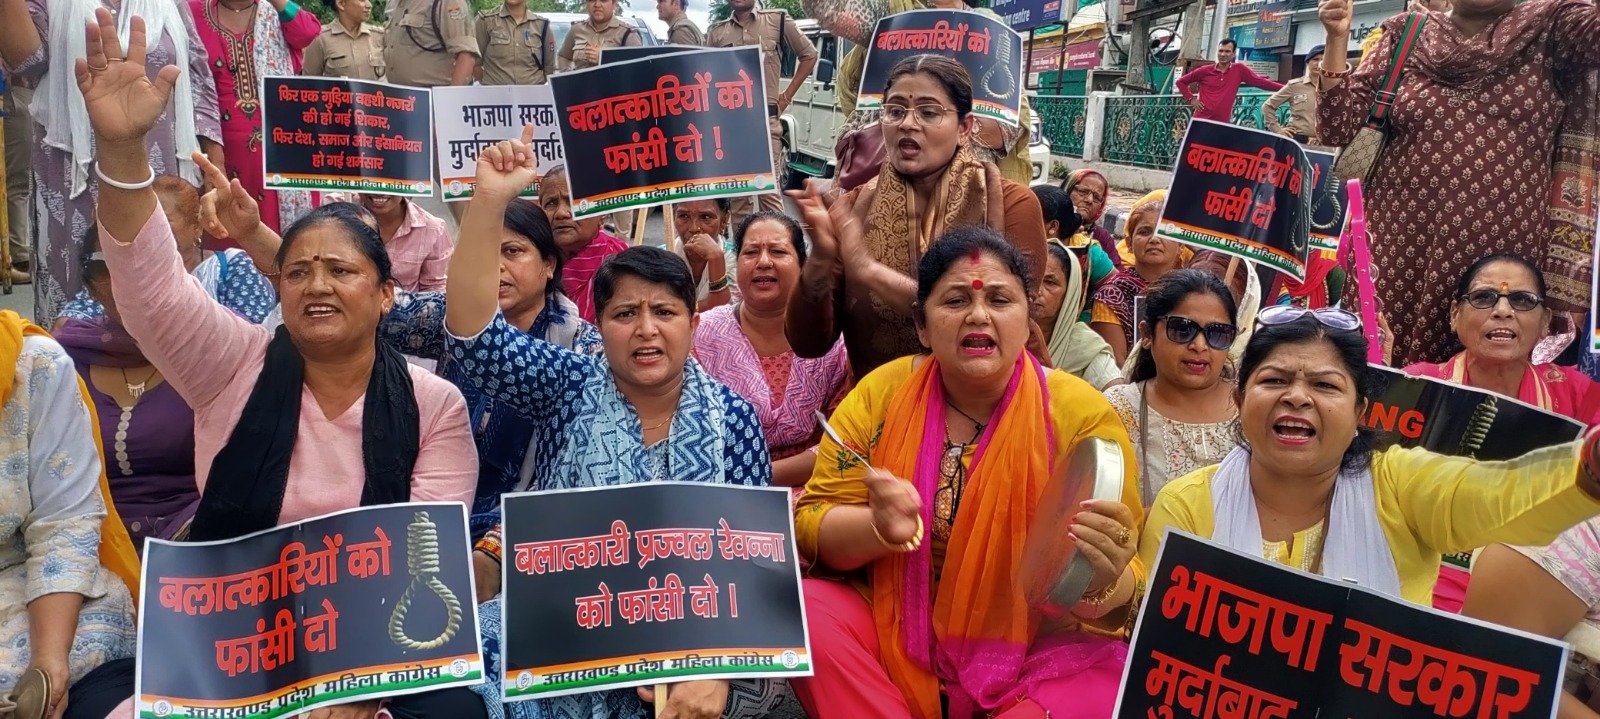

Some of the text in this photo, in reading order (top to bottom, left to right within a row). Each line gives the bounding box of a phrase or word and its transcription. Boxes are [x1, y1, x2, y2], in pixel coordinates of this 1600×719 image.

[877, 20, 992, 55] बलात्कारियों को
[279, 84, 299, 102] फिर
[301, 90, 319, 103] एक
[462, 105, 513, 127] भाजपा
[566, 69, 754, 133] बलात्कारियों को
[273, 127, 297, 144] फिर
[318, 133, 350, 147] समाज
[352, 131, 373, 148] और
[302, 108, 318, 124] की
[320, 107, 332, 126] हो
[334, 109, 351, 127] गई
[312, 151, 384, 170] हो गई शर्मसार
[604, 123, 725, 174] फांसी दो !
[1187, 142, 1295, 189] बलात्कारियों
[674, 182, 711, 196] महिला
[1204, 185, 1277, 231] फांसी दो
[1358, 401, 1425, 438] NG
[514, 517, 786, 575] बलात्कारी प्रज्वल रेवन्ना
[159, 526, 392, 616] बलात्कारियों को
[575, 582, 613, 630] को
[618, 573, 685, 625] फांसी
[689, 573, 719, 618] दो
[215, 598, 340, 678] फांसी दो
[1161, 564, 1541, 719] भाजपा सरकार
[541, 650, 775, 686] उत्तराखण्ड प्रदेश महिला कांग्रेस
[183, 664, 443, 719] उत्तराखण्ड प्रदेश महिला कांग्रेस
